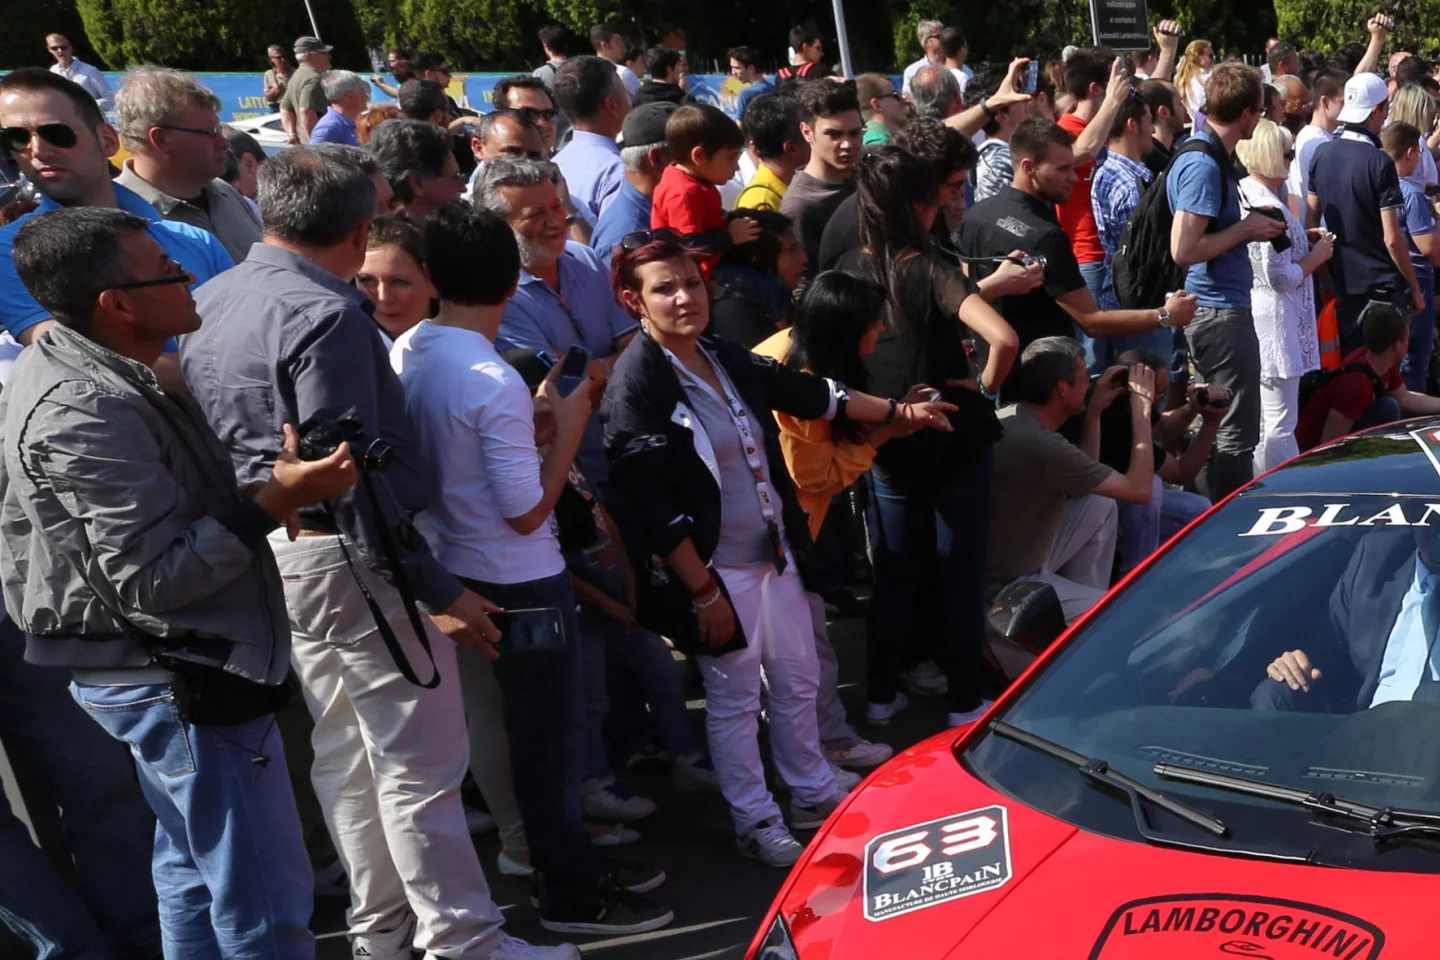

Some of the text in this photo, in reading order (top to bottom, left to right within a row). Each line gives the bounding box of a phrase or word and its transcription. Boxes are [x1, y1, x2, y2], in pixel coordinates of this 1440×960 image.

[873, 815, 998, 874] 63
[873, 862, 1002, 911] BLANCPAIN
[873, 898, 923, 917] MANUFACTURE
[934, 888, 958, 899] HAUTE
